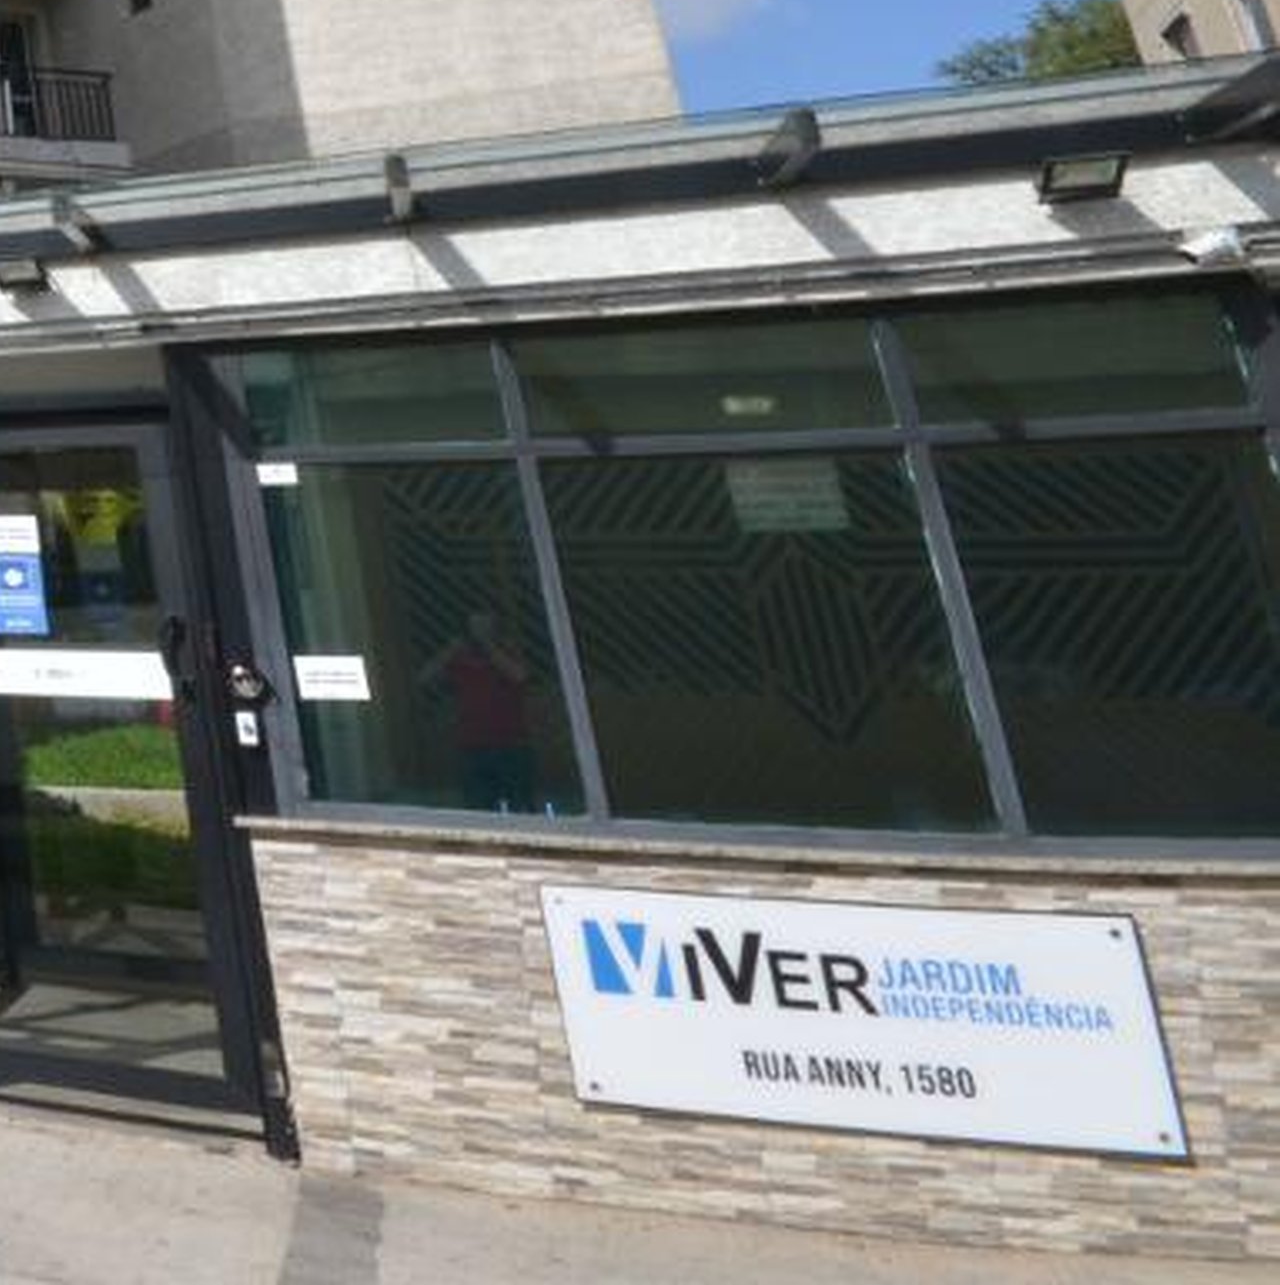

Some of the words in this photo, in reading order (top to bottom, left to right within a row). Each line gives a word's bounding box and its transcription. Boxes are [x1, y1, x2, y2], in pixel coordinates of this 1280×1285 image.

[877, 958, 1022, 996] JARDIM
[882, 993, 1114, 1031] INDEPENDÊNCIA
[742, 1049, 800, 1083] RUA
[807, 1056, 893, 1095] ANNY,
[900, 1064, 977, 1099] 1580
